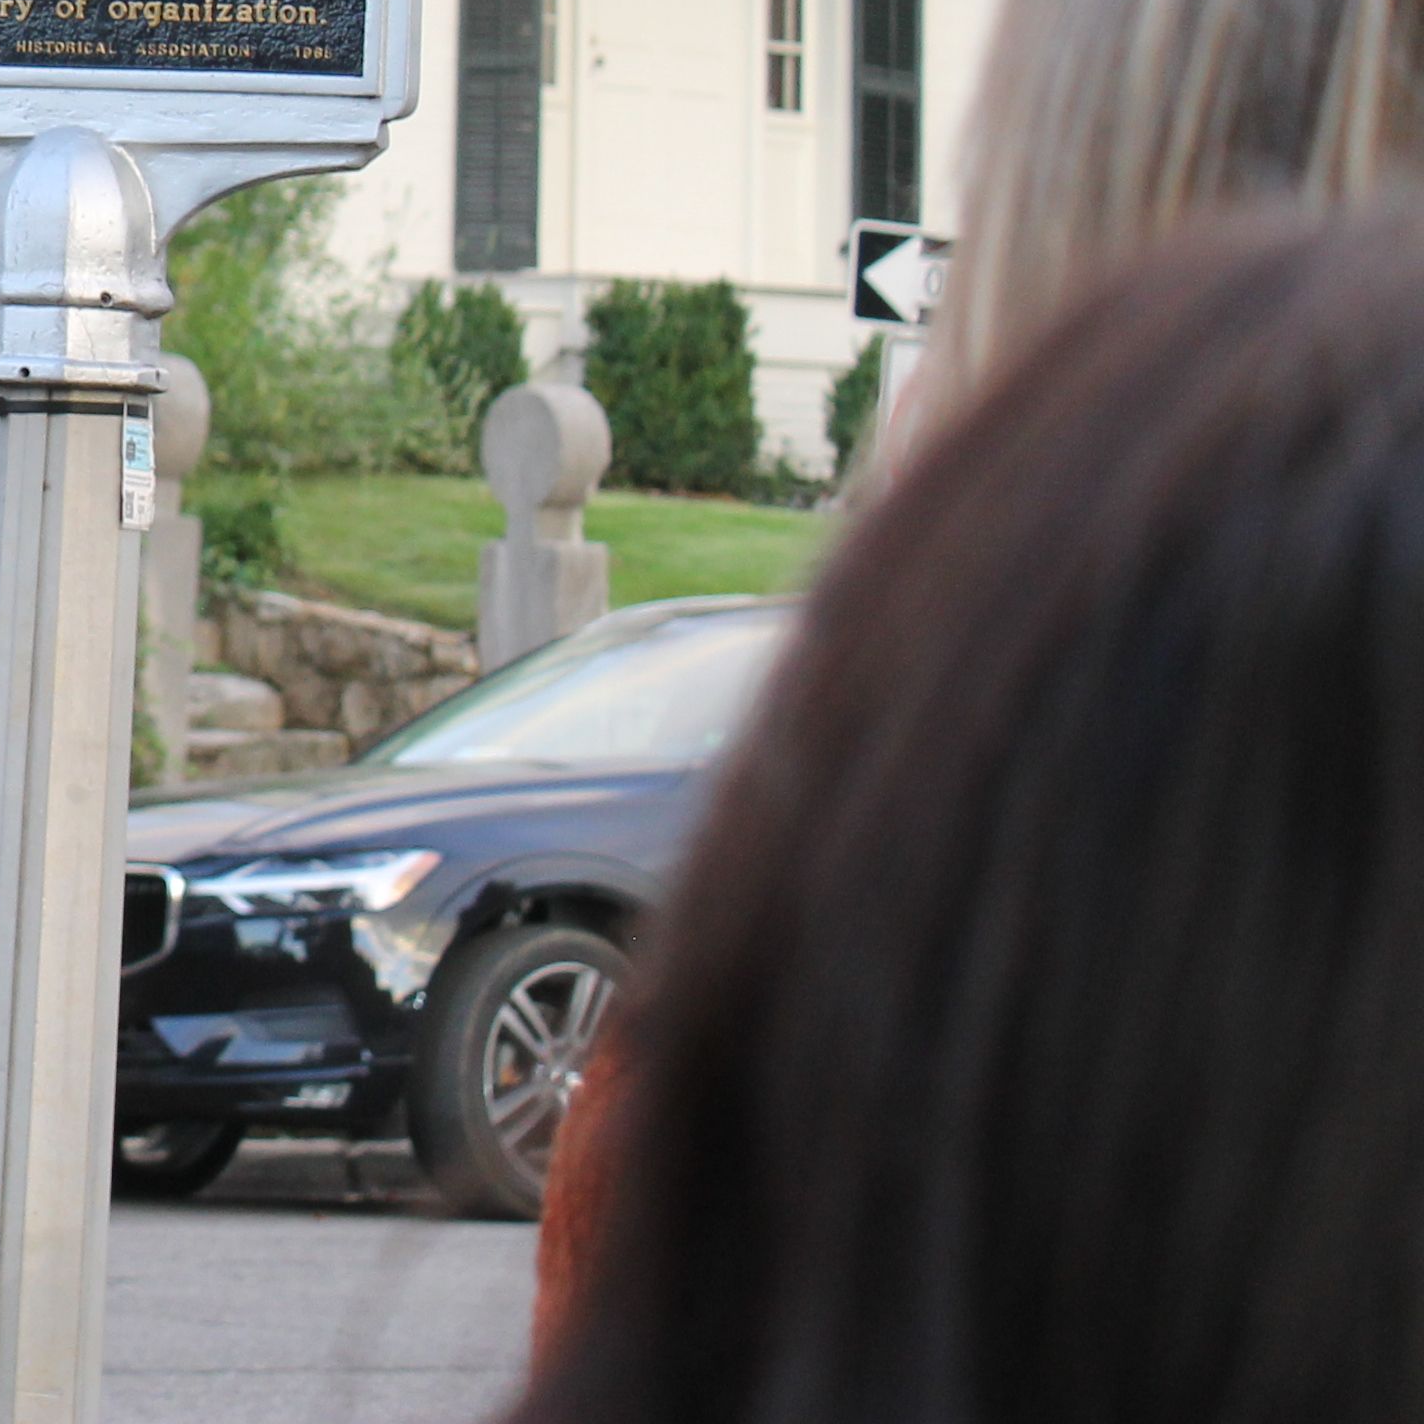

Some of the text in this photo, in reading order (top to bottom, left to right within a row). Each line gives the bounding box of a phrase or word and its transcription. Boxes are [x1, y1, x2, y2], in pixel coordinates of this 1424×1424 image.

[108, 0, 327, 27] organization.
[15, 41, 117, 55] HISTORICAL
[136, 44, 250, 58] ASSOCIATION
